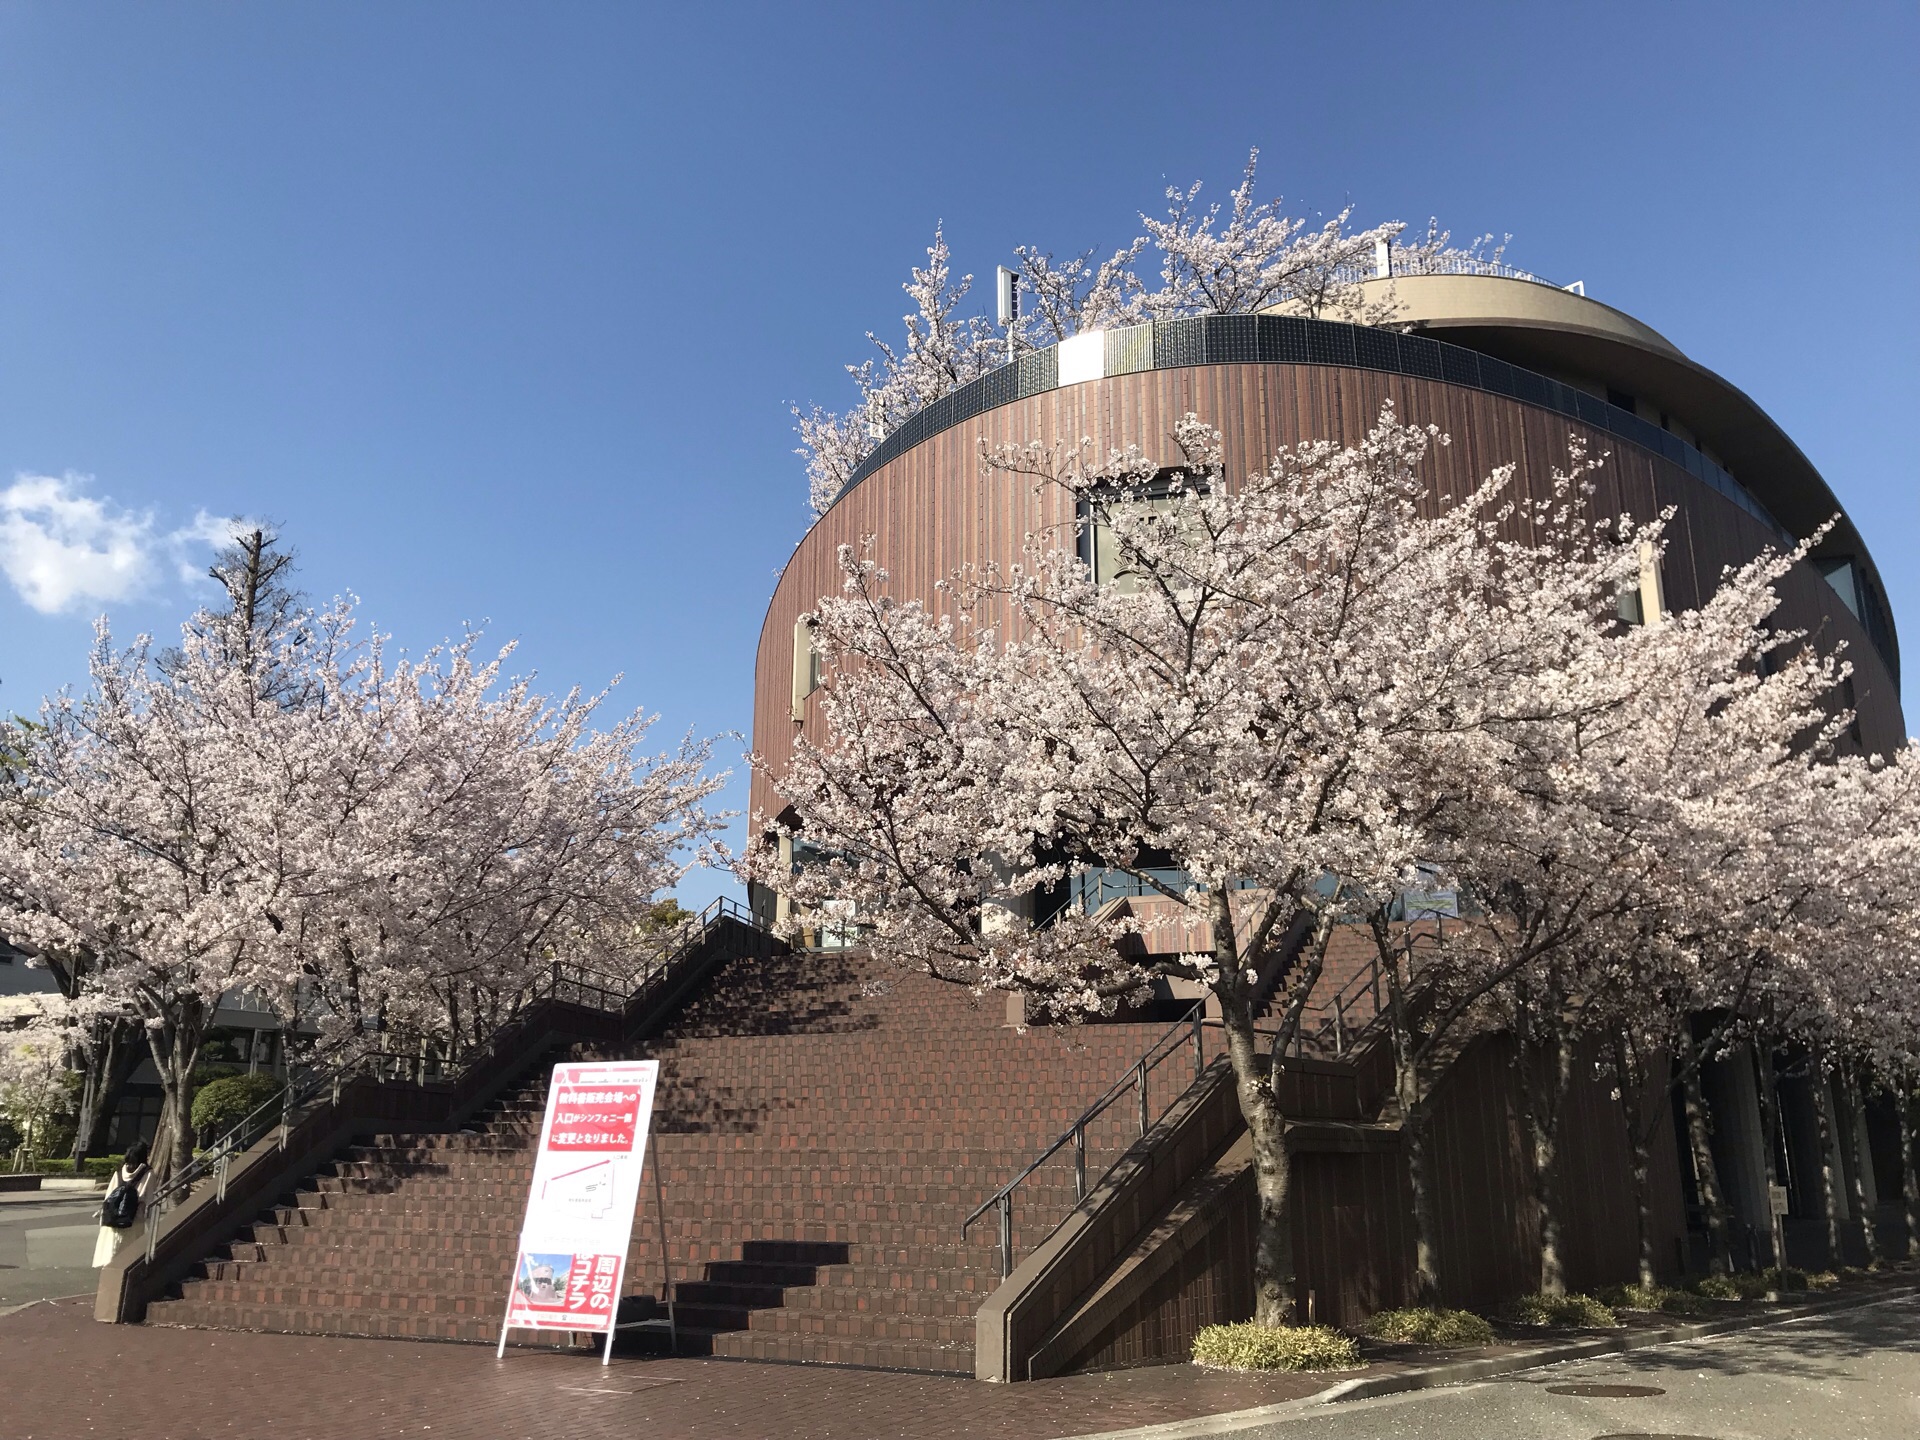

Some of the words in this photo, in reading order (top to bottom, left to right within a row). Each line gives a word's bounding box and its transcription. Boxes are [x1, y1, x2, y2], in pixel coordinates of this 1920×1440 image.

[551, 1132, 629, 1145] に変更となりました。
[590, 1256, 616, 1309] 周辺の
